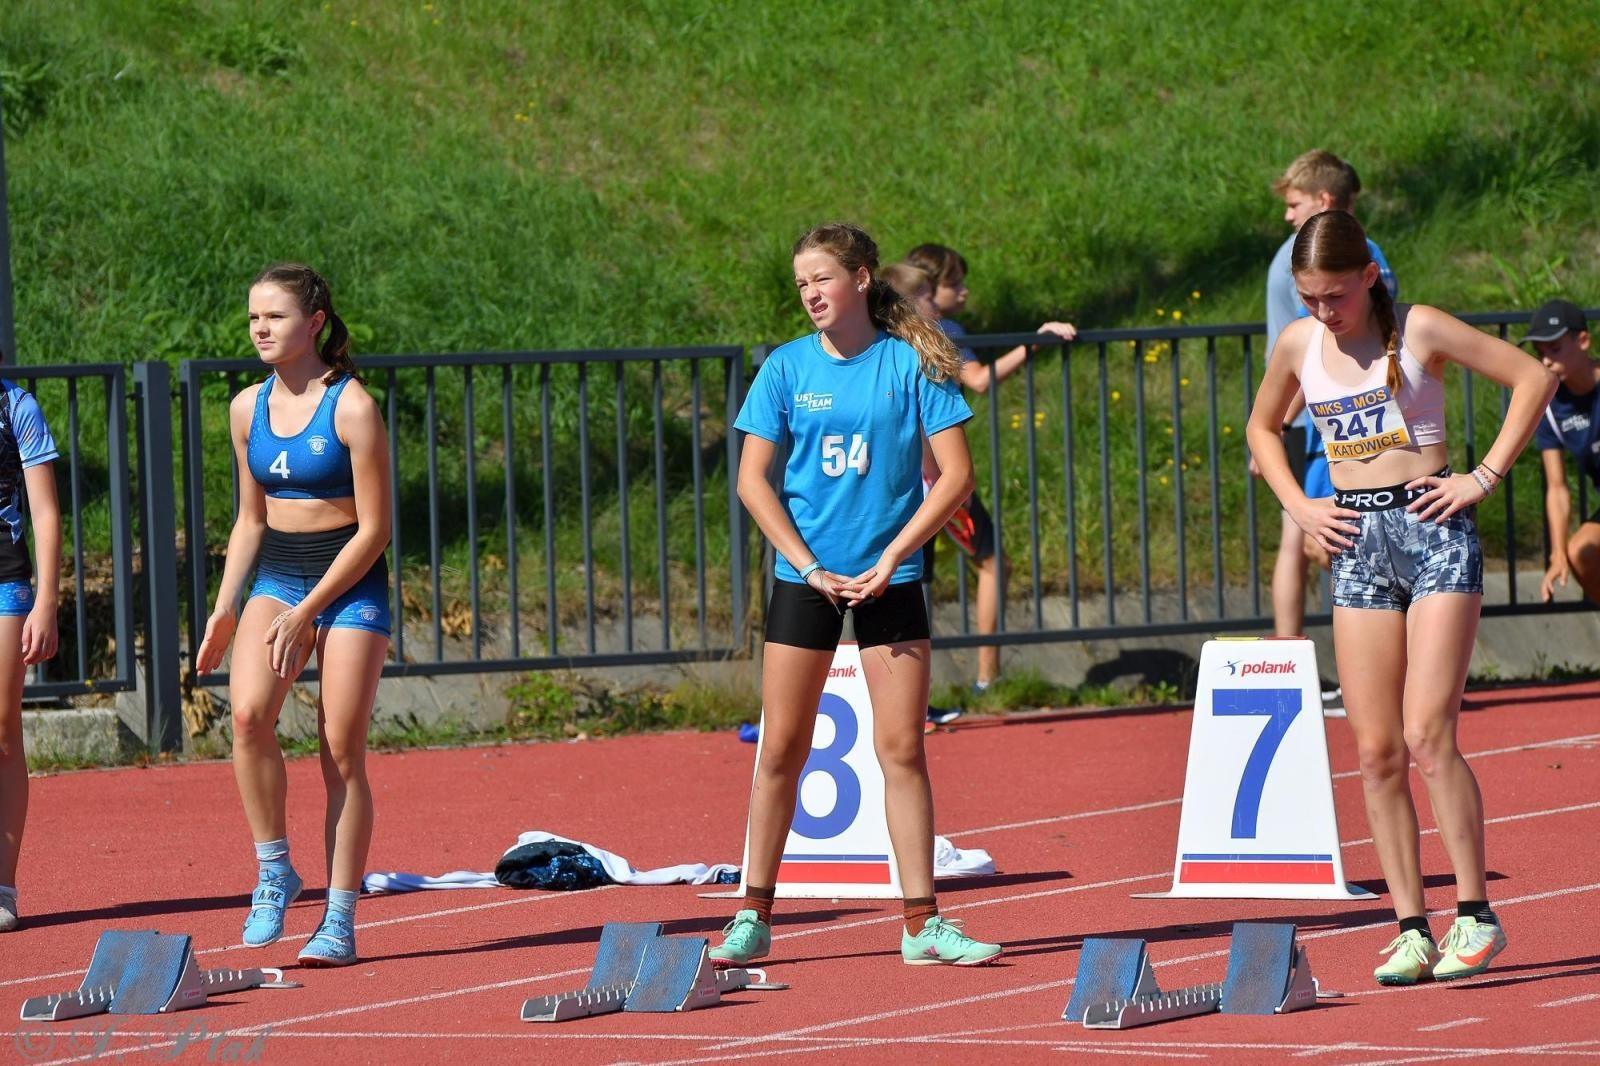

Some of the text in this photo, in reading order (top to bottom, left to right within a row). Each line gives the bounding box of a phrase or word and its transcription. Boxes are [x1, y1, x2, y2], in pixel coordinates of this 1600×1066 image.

[807, 398, 833, 409] TEAM
[1315, 401, 1344, 417] MKS
[1353, 389, 1387, 410] MOS
[1327, 405, 1386, 441] 247
[821, 433, 870, 478] 54
[1333, 432, 1402, 457] KATOWICE
[268, 450, 291, 480] 4
[1341, 490, 1394, 507] PRO
[828, 664, 858, 678] anik
[1241, 660, 1297, 677] polanik
[790, 692, 862, 840] 8
[1212, 688, 1303, 839] 7
[258, 889, 283, 902] NIKE
